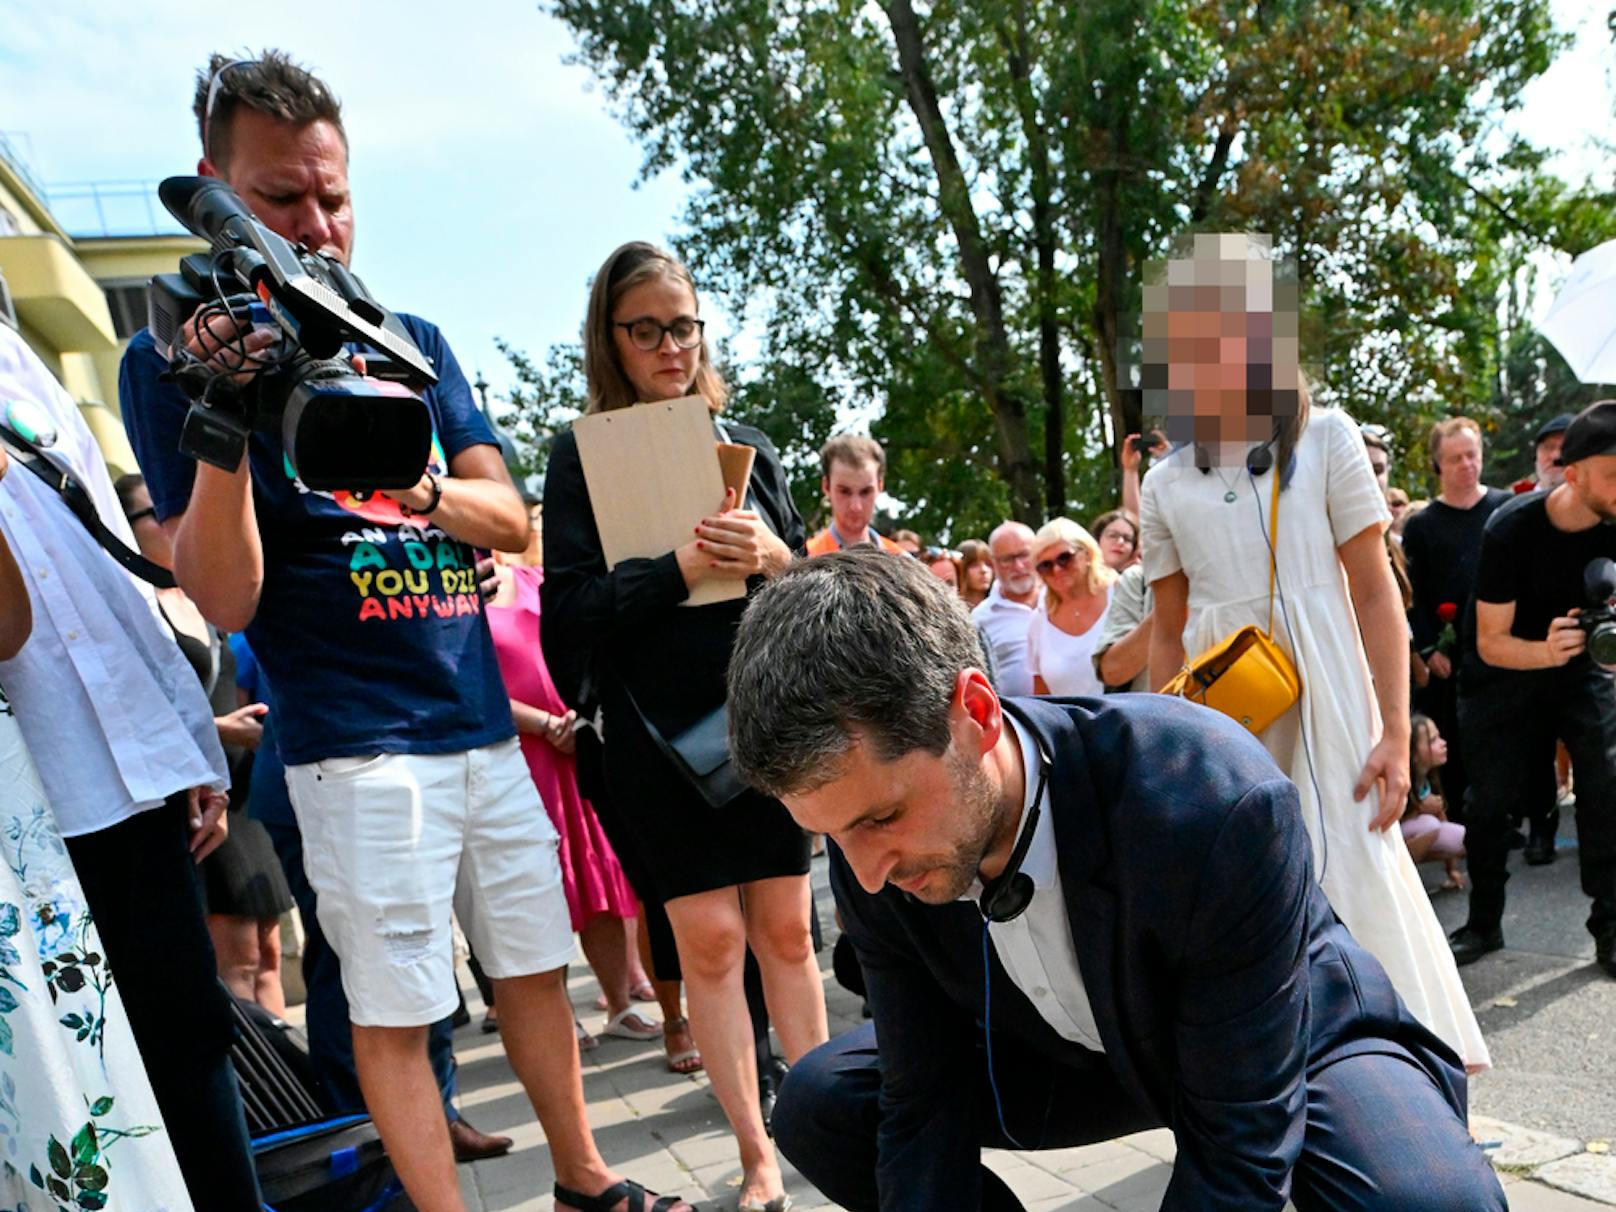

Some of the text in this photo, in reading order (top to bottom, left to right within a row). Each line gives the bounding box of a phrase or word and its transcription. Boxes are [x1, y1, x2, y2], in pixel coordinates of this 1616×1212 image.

[341, 527, 387, 546] AN
[350, 540, 387, 571] A
[350, 568, 429, 597] YOU
[358, 592, 480, 621] ANYWAY
